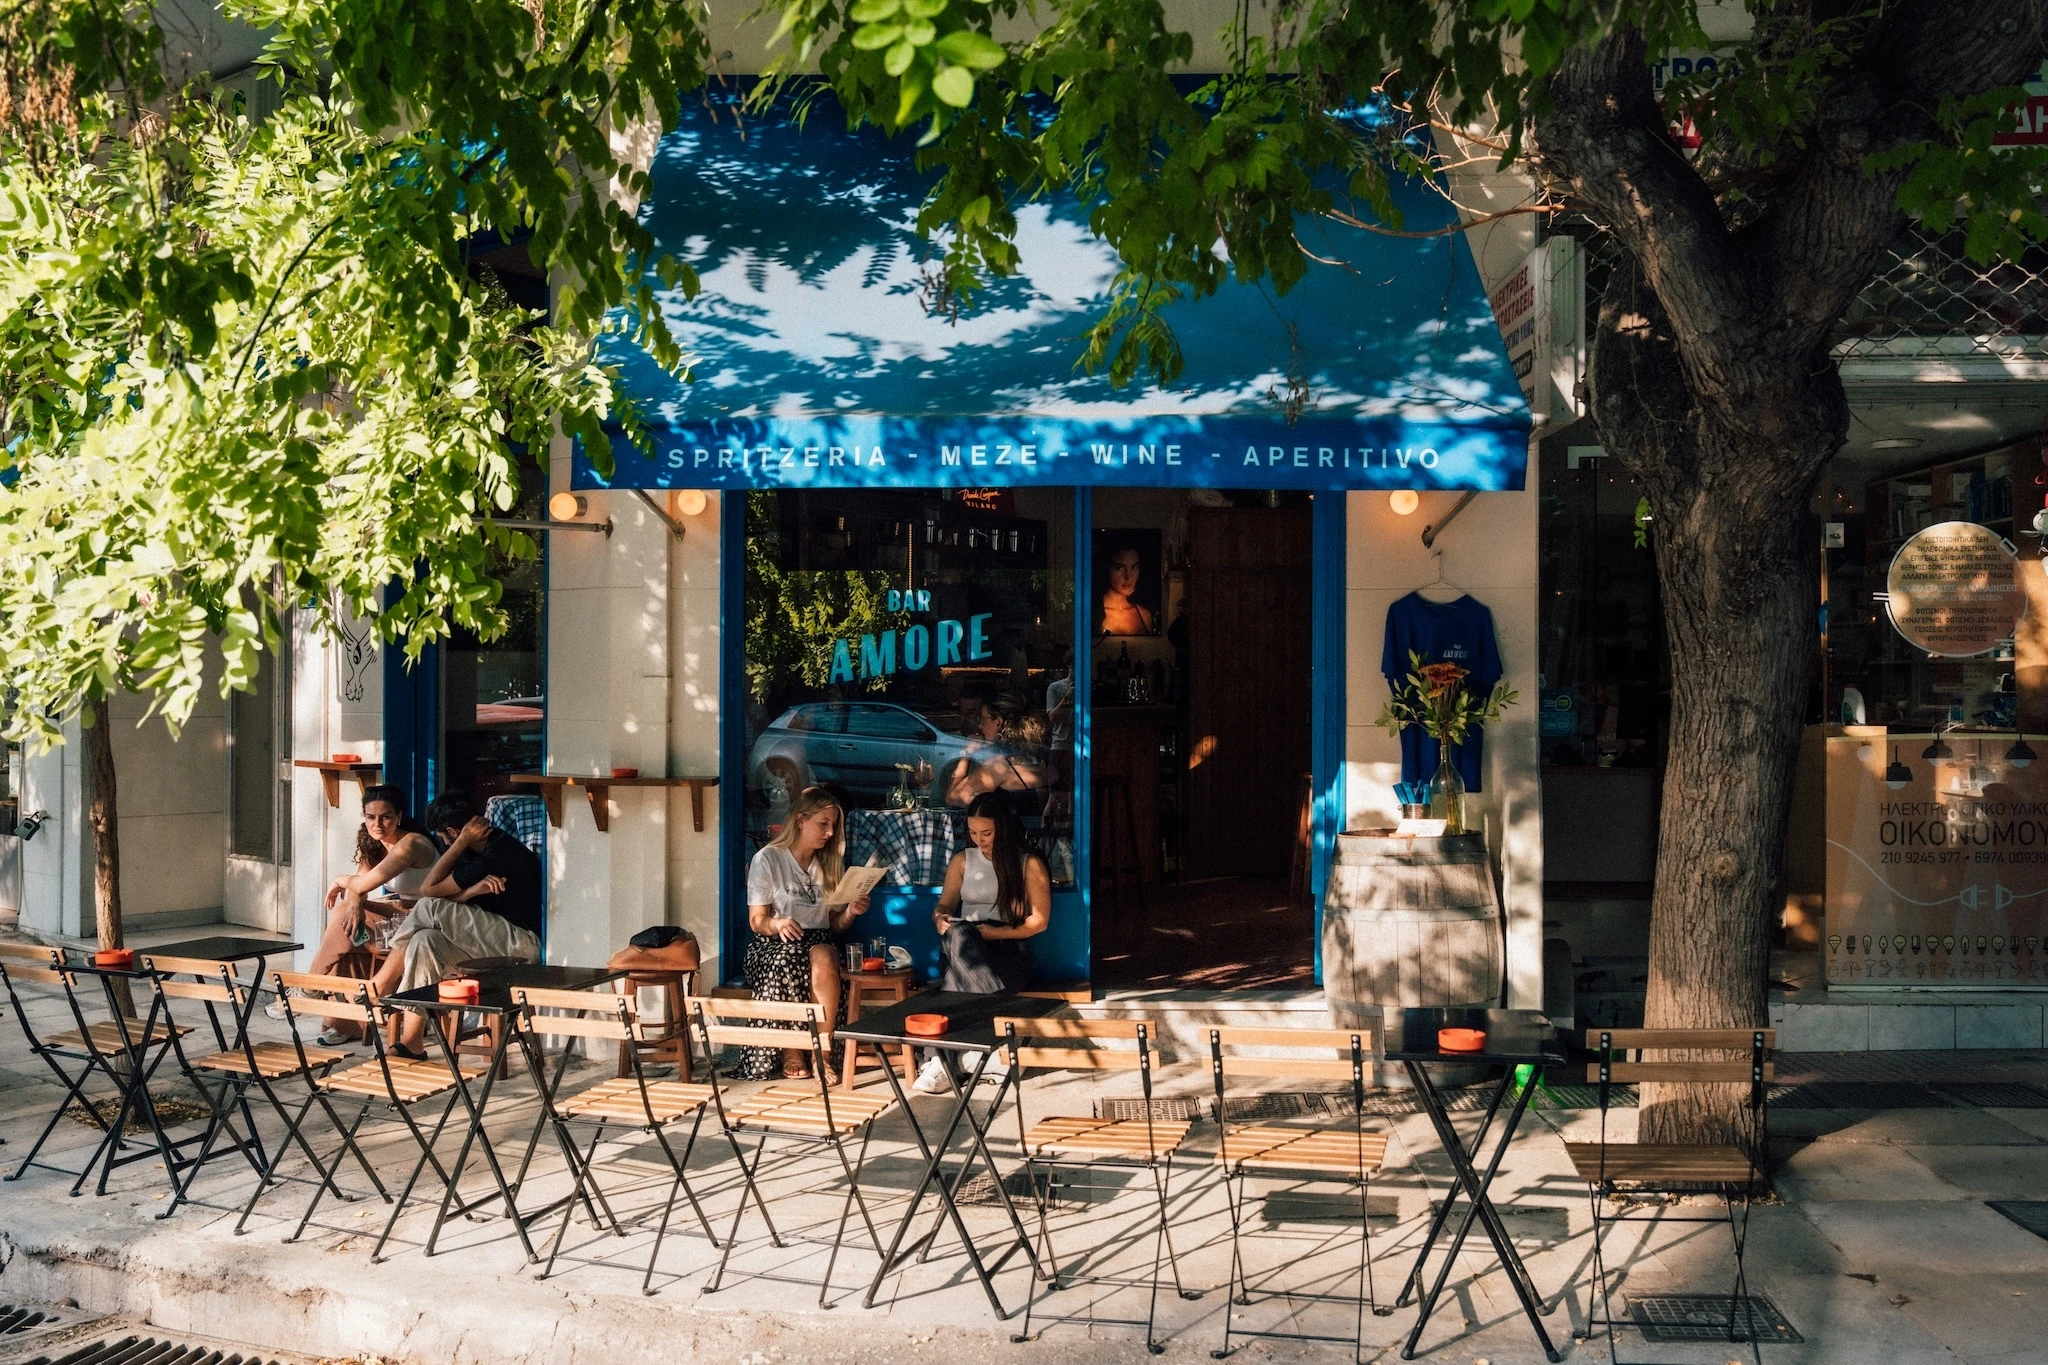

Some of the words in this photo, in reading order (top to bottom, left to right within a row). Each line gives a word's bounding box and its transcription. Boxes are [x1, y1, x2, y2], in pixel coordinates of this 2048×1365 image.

[667, 445, 887, 469] SPRITZERIA
[941, 444, 1037, 466] MEZE
[1091, 444, 1182, 466] WINE
[1243, 445, 1440, 469] APERITIVO
[888, 589, 932, 612] BAR
[829, 612, 993, 685] AMORE
[1880, 803, 2006, 816] ΗΛΕΚΤΡΟΟΓΙΚΟ
[1881, 852, 1901, 864] 210
[1905, 852, 1936, 864] 9245
[1939, 852, 1961, 864] 977
[1975, 852, 2004, 864] 6974
[2009, 852, 2048, 864] 00939
